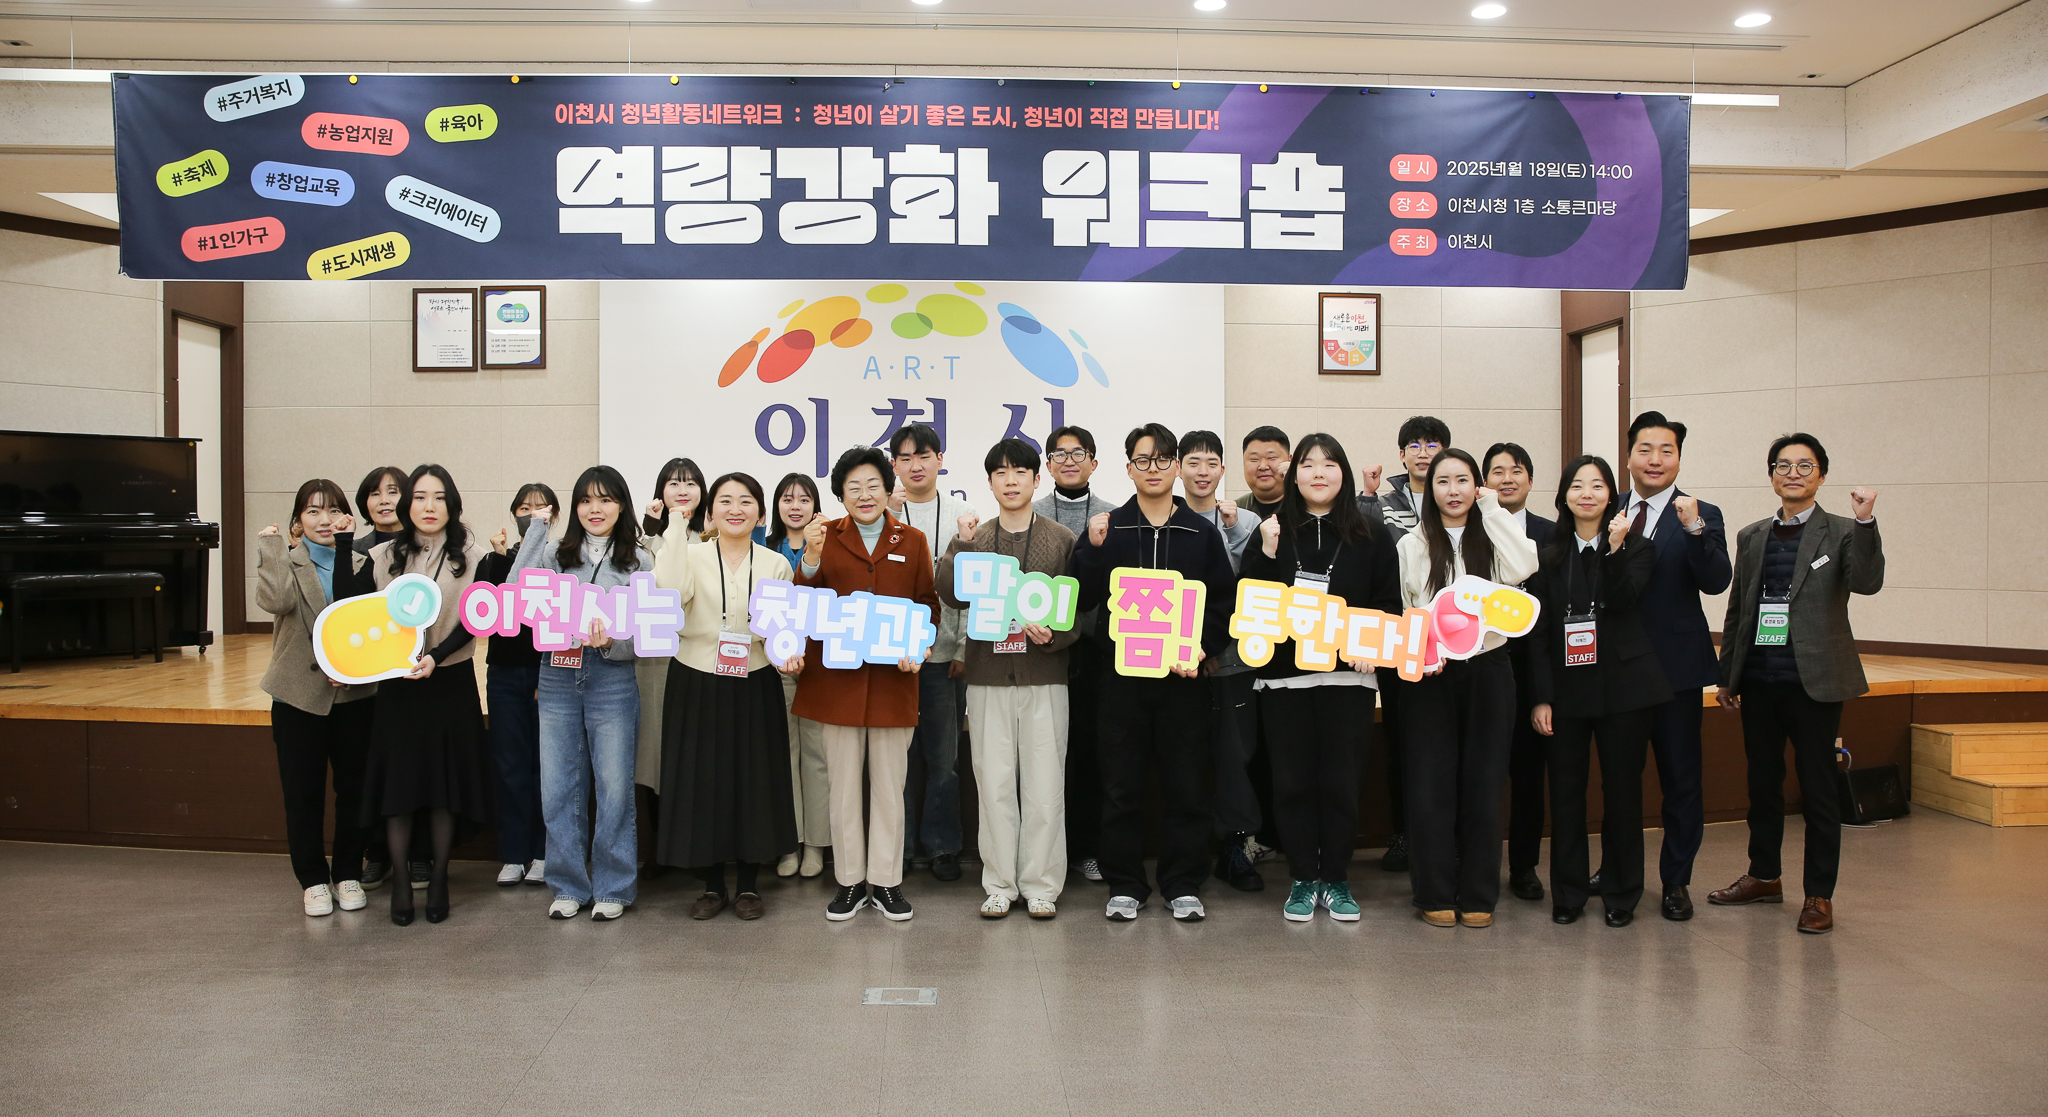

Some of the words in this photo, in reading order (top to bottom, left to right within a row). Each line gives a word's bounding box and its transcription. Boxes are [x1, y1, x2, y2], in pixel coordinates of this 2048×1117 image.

[217, 79, 293, 112] #주거복지
[439, 113, 483, 132] #육아
[555, 103, 615, 125] 이천시
[621, 103, 783, 125] 청년활동네트워크
[813, 104, 873, 126] 청년이
[879, 104, 919, 126] 살기
[926, 104, 966, 126] 좋은
[972, 104, 1017, 128] 도시,
[1023, 106, 1083, 128] 청년이
[1090, 107, 1129, 129] 직접
[1134, 108, 1220, 131] 만듭니다!
[317, 122, 393, 146] #농업지원
[171, 158, 218, 187] #축제
[265, 171, 340, 197] #창업교육
[398, 185, 489, 233] #크리에이터
[556, 144, 999, 246] 역량강화
[1041, 149, 1346, 251] 워크숍
[1447, 198, 1507, 214] 이천시청
[1514, 198, 1535, 214] 1층
[1541, 200, 1617, 216] 소통큰마당
[197, 227, 269, 252] #1인가구
[1447, 234, 1493, 250] 이천시
[321, 240, 397, 273] #도시재생
[961, 560, 1072, 634] 말이
[465, 575, 678, 650] 이천시는
[755, 585, 929, 662] 청년과
[1117, 576, 1198, 669] 쫌!
[1236, 585, 1424, 675] 통한다!
[1758, 634, 1786, 643] STAFF
[996, 642, 1024, 650] STAFF
[1568, 652, 1594, 663] STAFF
[553, 655, 580, 666] STAFF
[717, 663, 746, 675] STAFF
